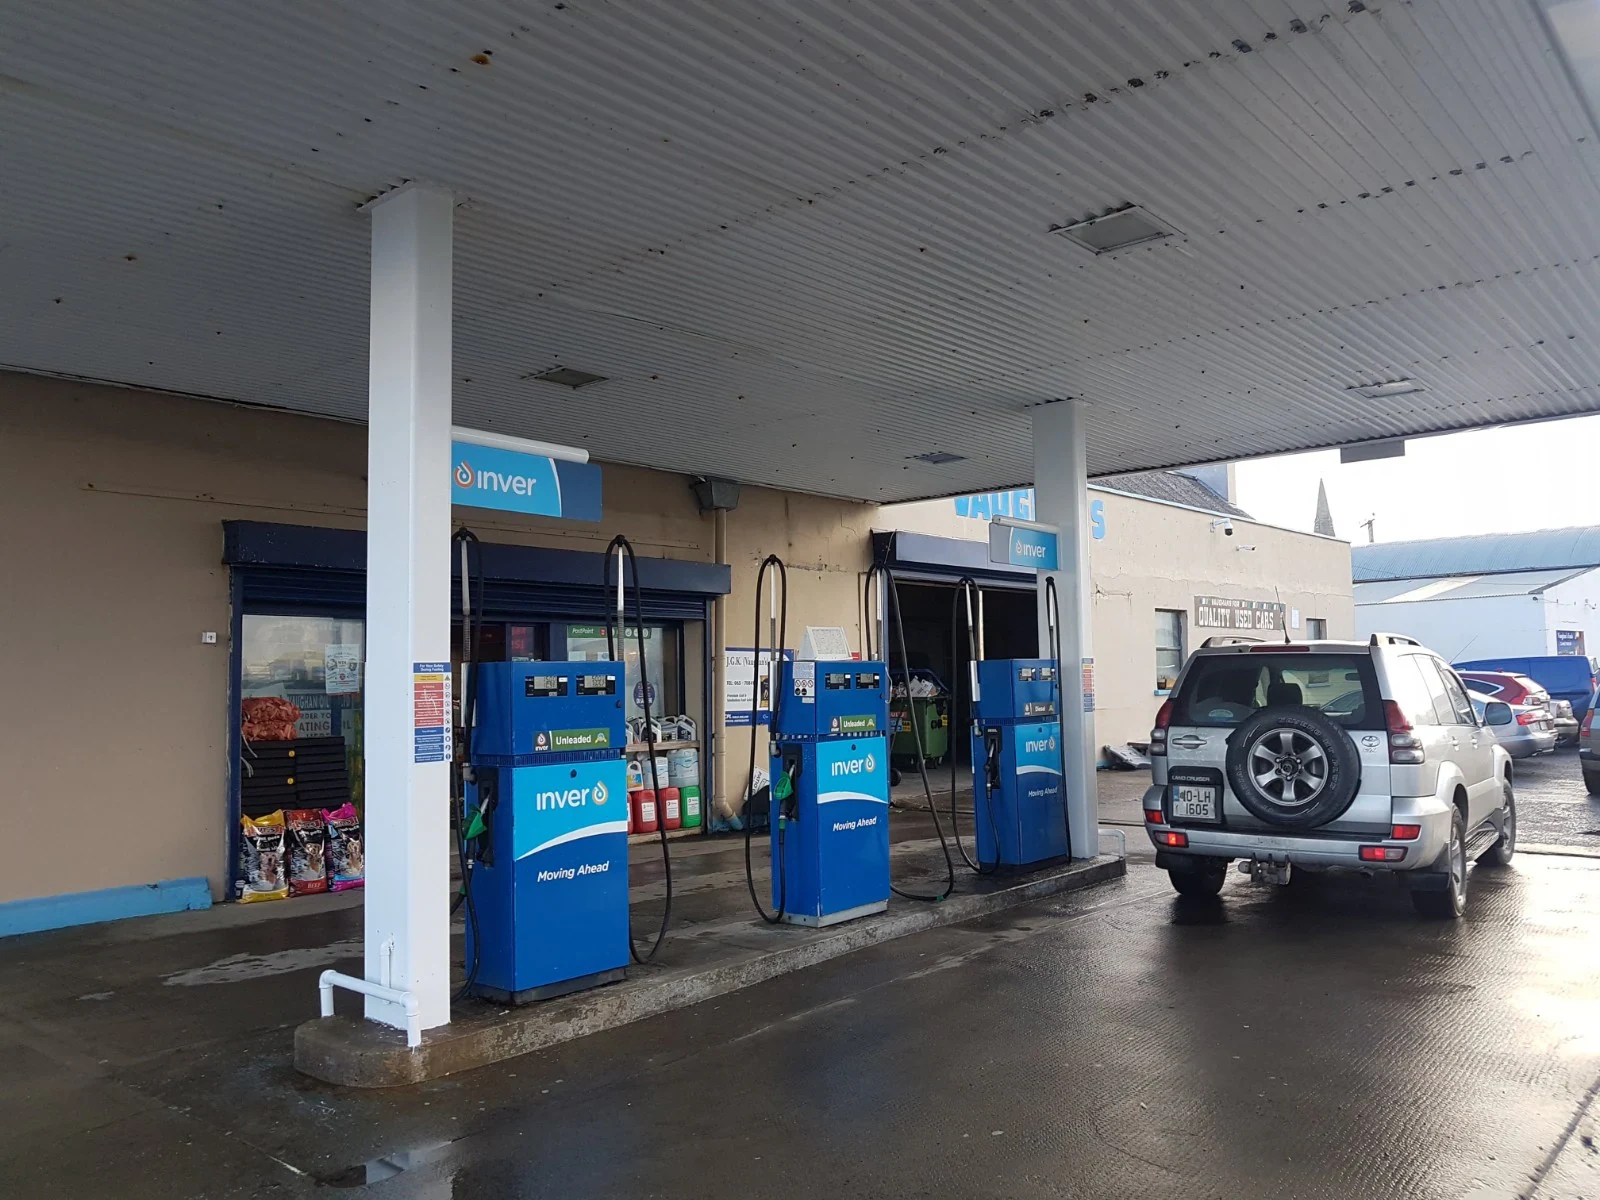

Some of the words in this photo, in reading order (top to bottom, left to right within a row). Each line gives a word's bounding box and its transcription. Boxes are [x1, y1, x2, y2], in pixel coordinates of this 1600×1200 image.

[477, 470, 537, 496] inver
[954, 487, 1106, 540] VAUGS
[1023, 543, 1046, 558] inver
[1198, 606, 1231, 627] QUALITY
[1234, 609, 1252, 628] USED
[1255, 611, 1274, 629] CARS
[299, 721, 330, 732] ATING
[843, 719, 866, 728] Unleaded
[555, 734, 592, 745] Unleaded
[1026, 737, 1048, 753] inver
[831, 759, 863, 777] inver
[536, 788, 590, 811] inver
[1028, 788, 1044, 798] Moving
[1044, 786, 1058, 795] Ahead
[1186, 803, 1209, 816] 1605
[832, 821, 856, 832] Moving
[857, 816, 877, 829] Ahead
[536, 868, 575, 882] Moving
[577, 860, 610, 876] Ahead
